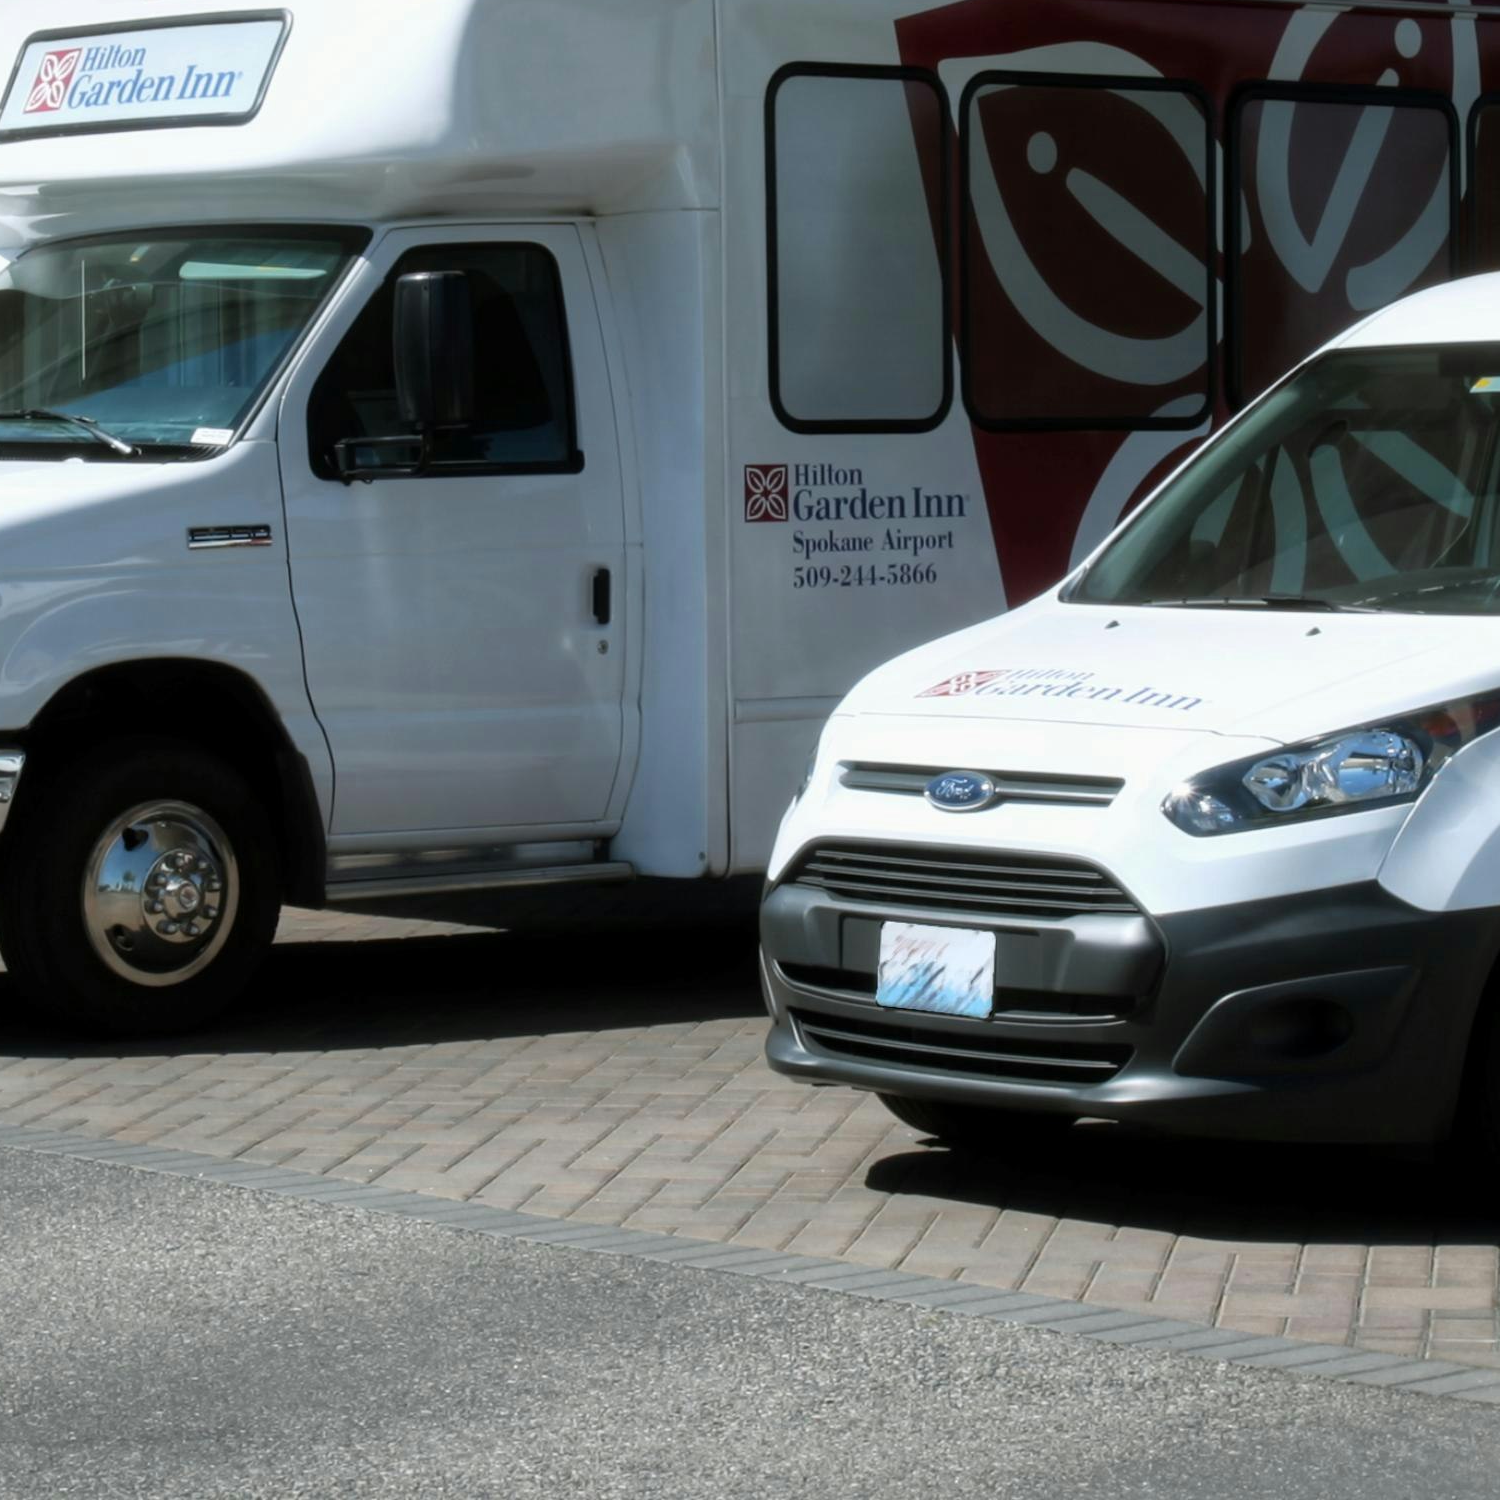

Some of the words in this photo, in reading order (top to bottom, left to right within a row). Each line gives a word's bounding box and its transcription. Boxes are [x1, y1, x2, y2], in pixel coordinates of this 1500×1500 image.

[79, 44, 147, 72] Hilton
[67, 69, 180, 110] Garden
[176, 65, 238, 100] Inn
[793, 464, 863, 487] Hilton
[792, 488, 906, 522] Garden
[912, 487, 966, 518] Inn
[792, 529, 874, 560] Spokane
[881, 528, 954, 556] Airport
[792, 563, 938, 589] 509-244-5866
[975, 680, 1123, 701] Garden
[1122, 686, 1203, 711] Inn
